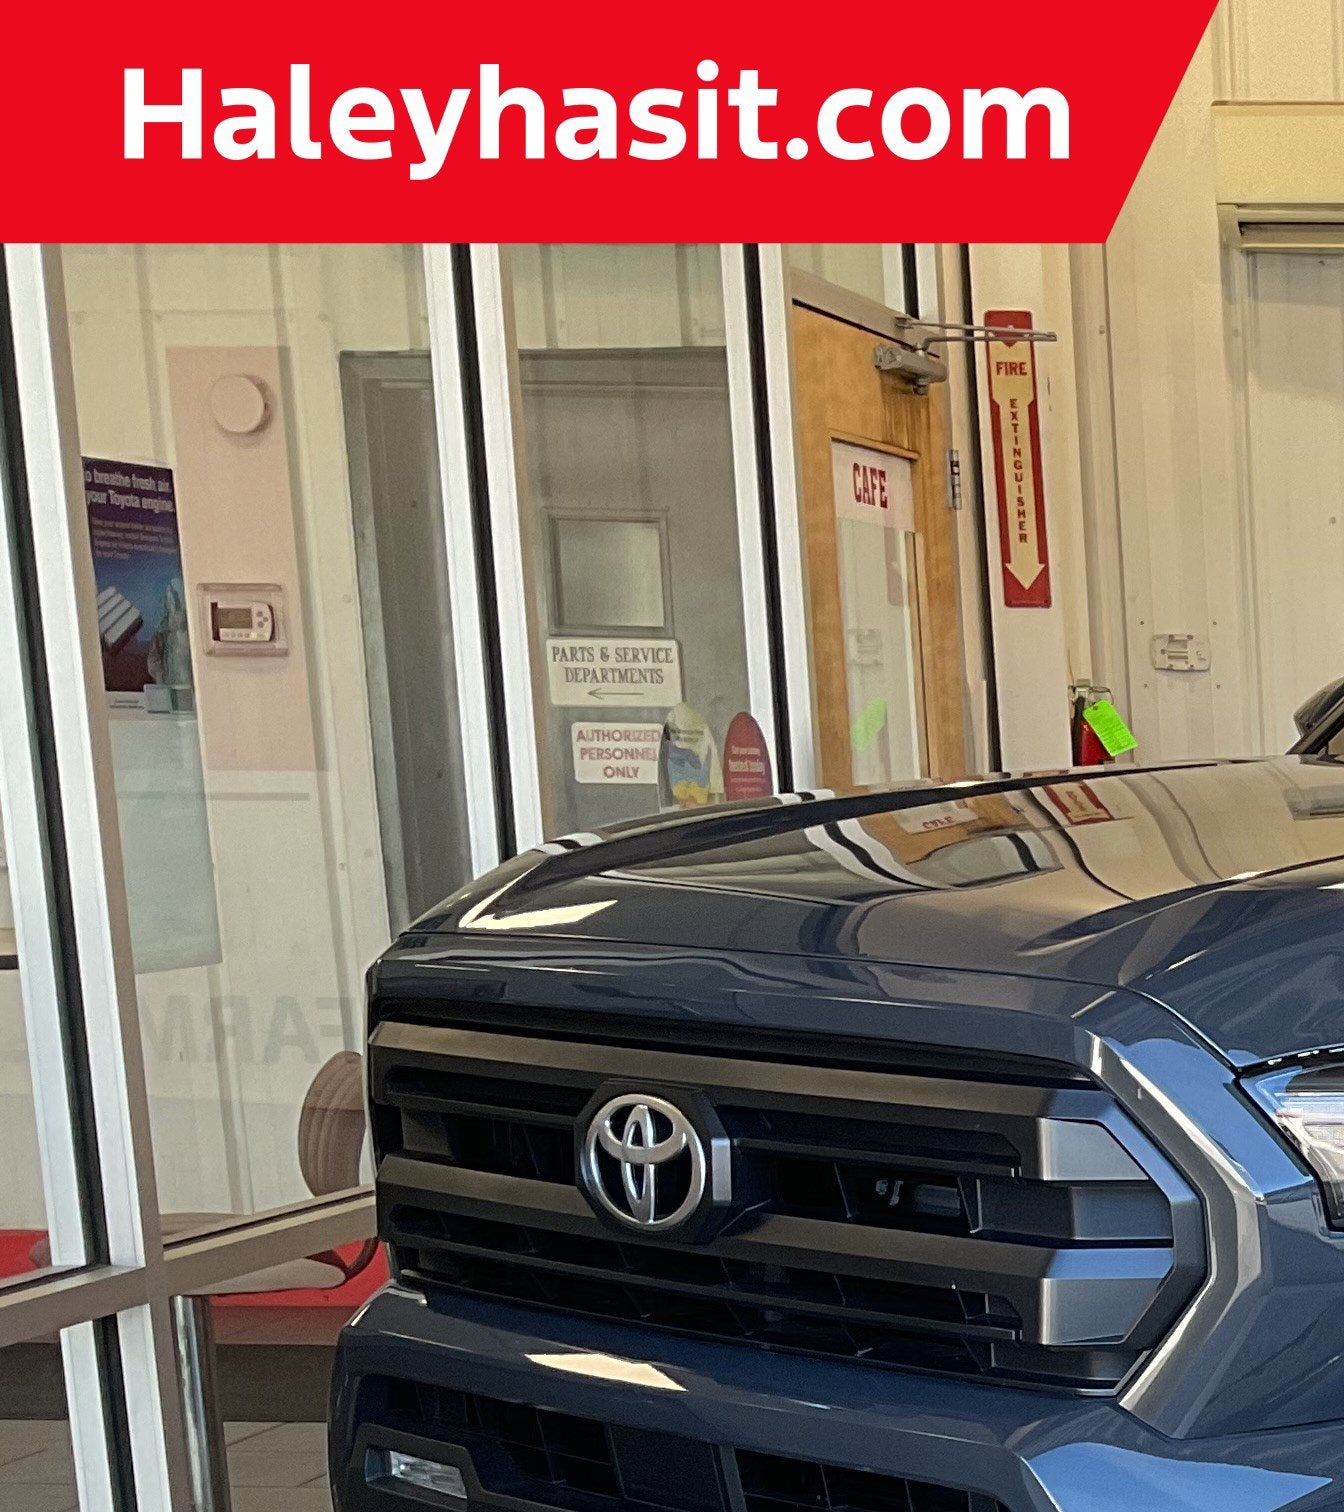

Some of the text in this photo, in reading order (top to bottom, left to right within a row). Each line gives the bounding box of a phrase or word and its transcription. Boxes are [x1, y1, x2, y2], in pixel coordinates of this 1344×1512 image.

[996, 361, 1028, 377] FIRE
[1009, 398, 1028, 543] EXTINGUISHER
[852, 462, 888, 509] CAFE
[108, 489, 140, 510] Toyota
[552, 646, 674, 664] PARTS & SERVICE
[565, 667, 664, 684] DEPARTMENTS
[576, 729, 660, 742] AUTHORIZED
[579, 748, 659, 761] PERSONNEL
[603, 765, 640, 778] ONLY
